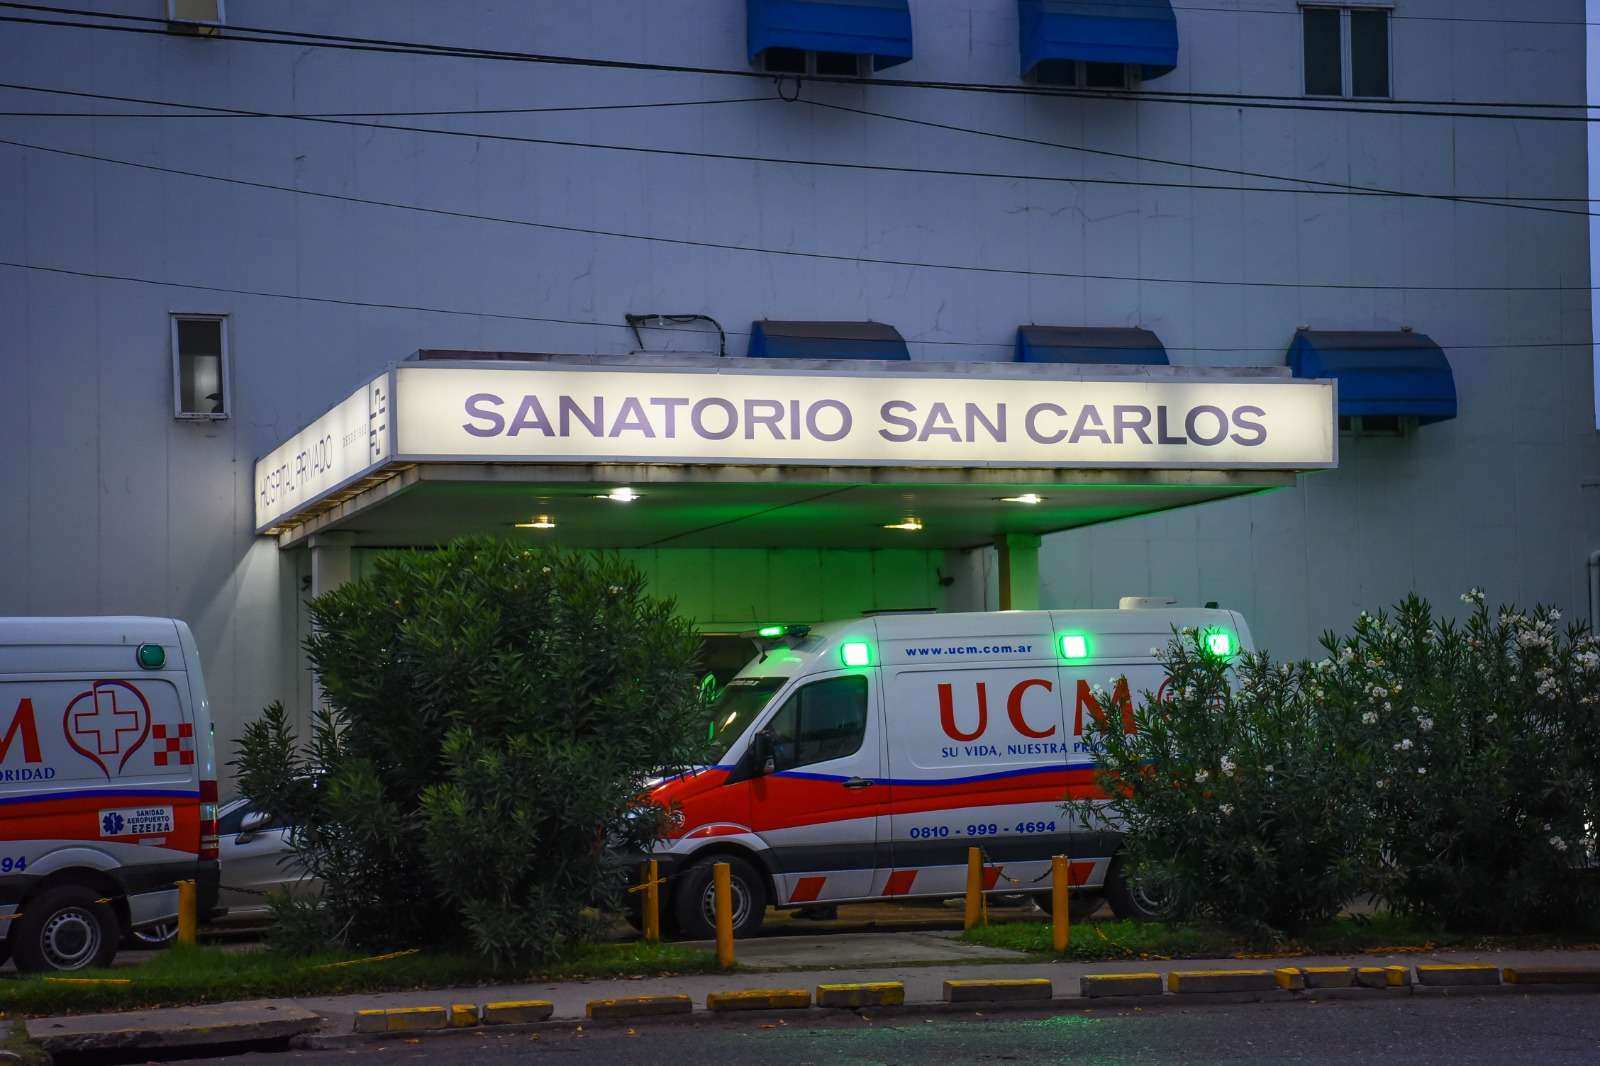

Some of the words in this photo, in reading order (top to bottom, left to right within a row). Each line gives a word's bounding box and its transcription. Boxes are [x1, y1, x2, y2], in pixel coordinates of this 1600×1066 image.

[462, 393, 852, 441] SANATORIO
[878, 399, 1007, 443] SAN
[1024, 402, 1268, 447] CARLOS
[259, 461, 295, 512] HOSPITAL
[296, 433, 333, 486] PRIVADO
[905, 643, 1033, 657] www.ucm.com.ar
[937, 679, 1138, 742] UCM
[941, 747, 959, 758] SU
[965, 745, 1002, 757] VIDA,
[1007, 742, 1068, 755] NUESTRA
[127, 816, 170, 824] AEROPUERTO
[136, 809, 165, 817] SANIDAD
[131, 823, 170, 833] EZEIZA
[910, 826, 949, 838] 0810
[966, 824, 998, 836] 999
[1015, 821, 1056, 834] 4694
